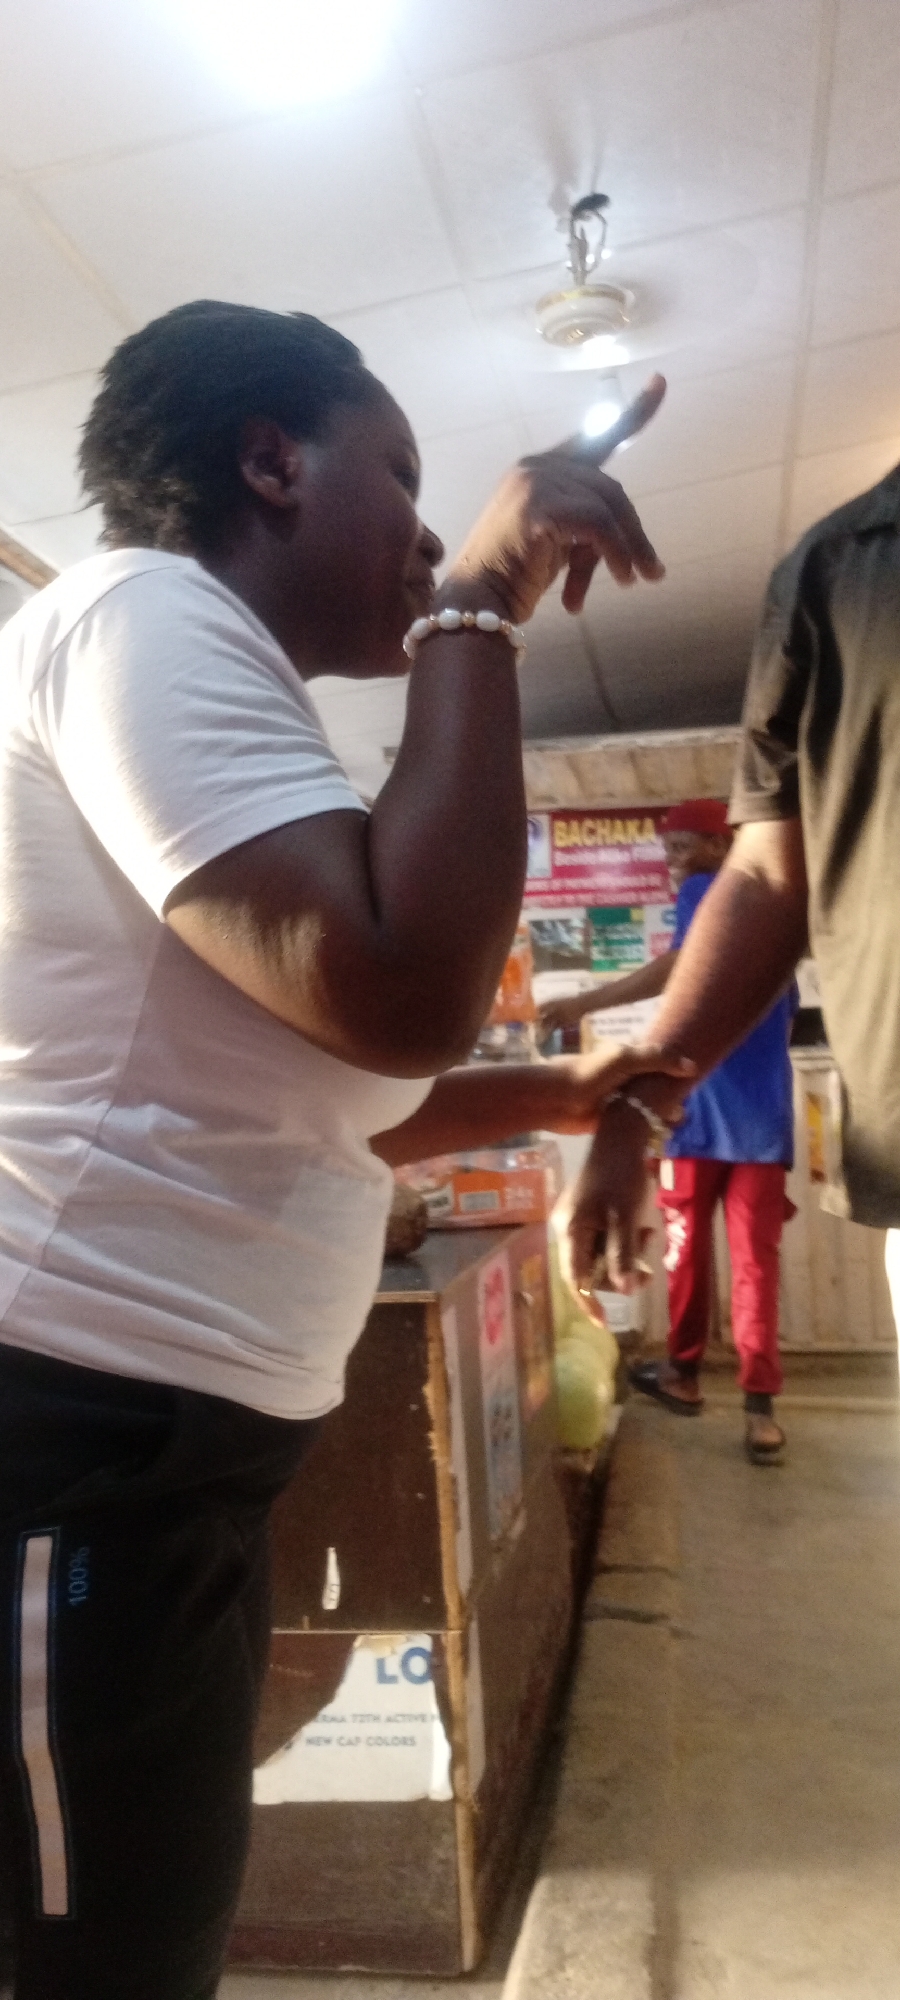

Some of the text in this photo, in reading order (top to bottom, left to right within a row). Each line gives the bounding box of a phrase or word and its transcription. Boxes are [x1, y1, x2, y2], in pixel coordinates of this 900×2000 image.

[553, 818, 656, 847] BACHAKA
[67, 1546, 90, 1605] 100%
[305, 1736, 332, 1747] NEW
[336, 1736, 361, 1747] CAP
[365, 1736, 417, 1747] COLORS
